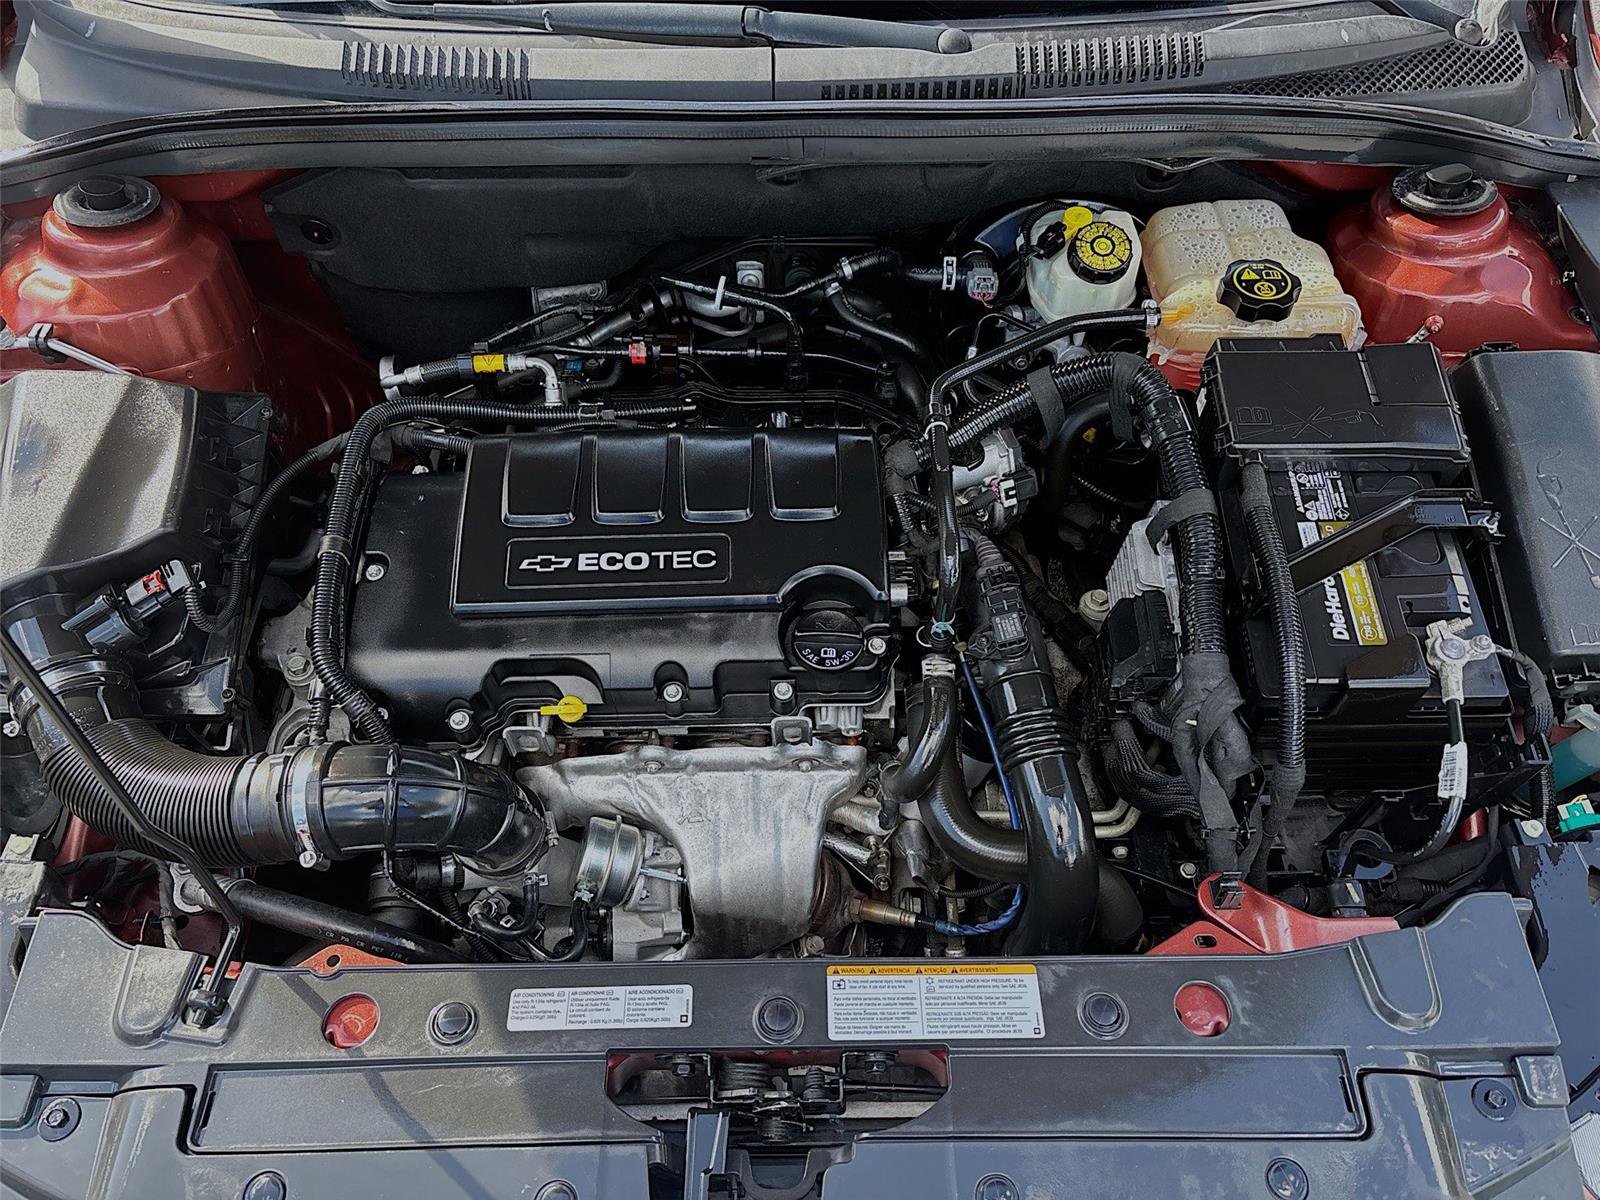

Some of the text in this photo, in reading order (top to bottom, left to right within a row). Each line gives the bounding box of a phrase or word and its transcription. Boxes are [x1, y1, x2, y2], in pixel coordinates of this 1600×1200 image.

[578, 550, 716, 571] ECOTEC
[802, 648, 854, 666] SAE 5W-30
